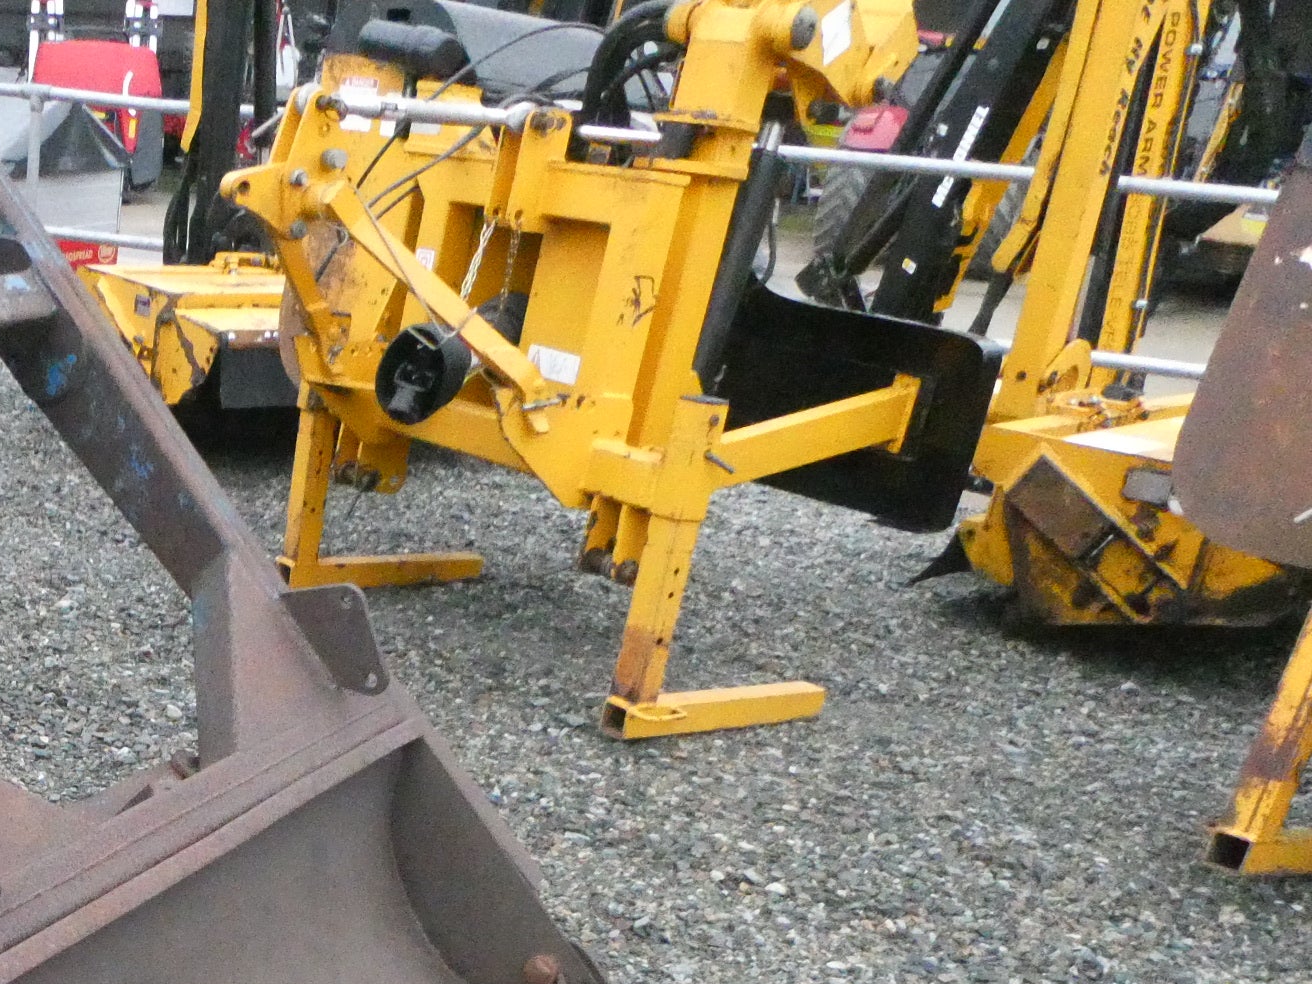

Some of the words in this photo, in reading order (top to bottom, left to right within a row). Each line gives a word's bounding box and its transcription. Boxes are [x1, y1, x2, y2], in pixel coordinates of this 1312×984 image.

[1152, 11, 1181, 108] POWER
[931, 105, 990, 208] McONNEL
[1136, 117, 1157, 176] ARM
